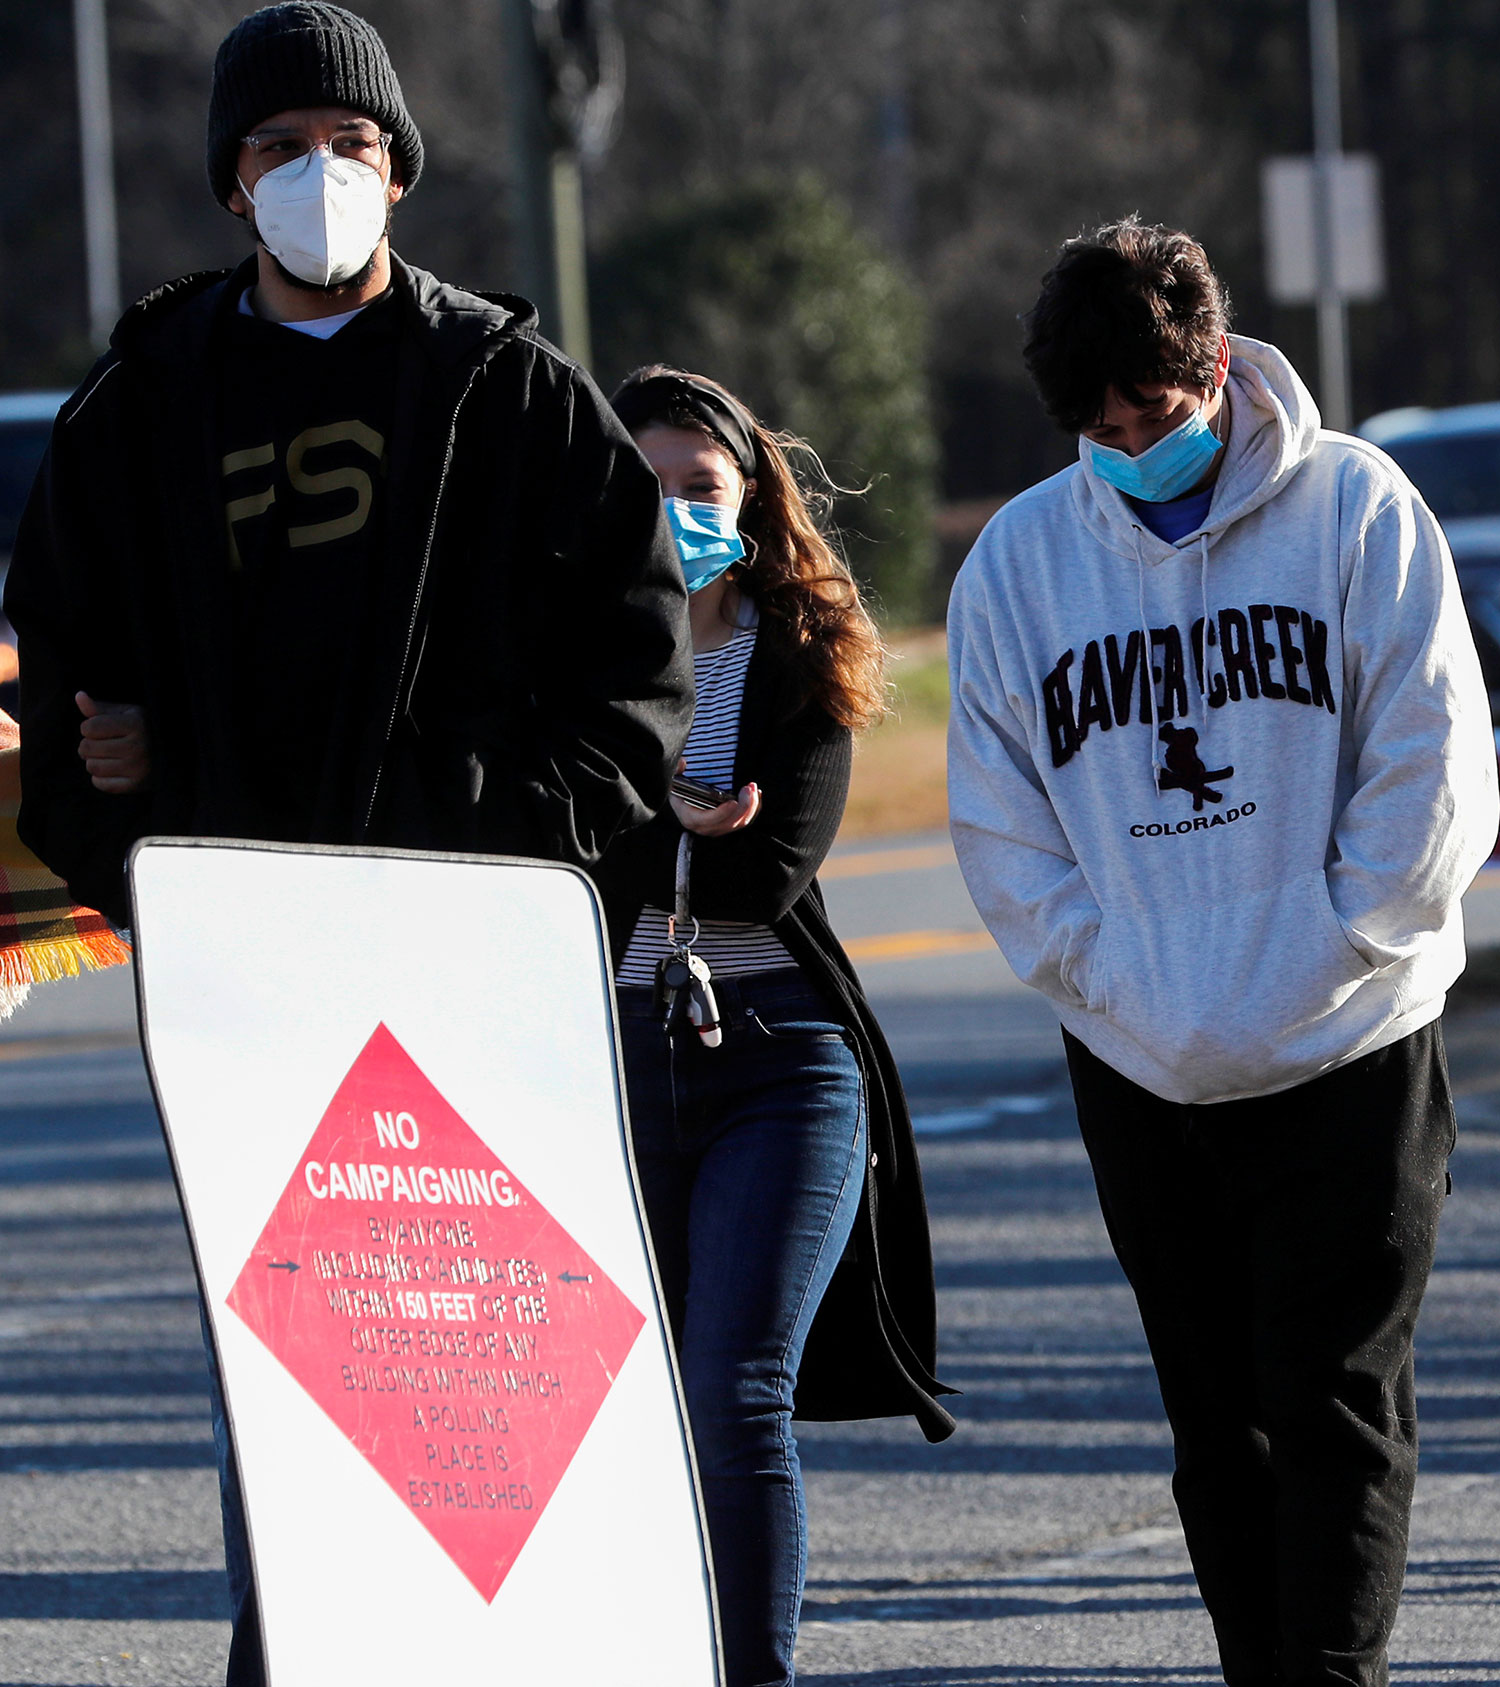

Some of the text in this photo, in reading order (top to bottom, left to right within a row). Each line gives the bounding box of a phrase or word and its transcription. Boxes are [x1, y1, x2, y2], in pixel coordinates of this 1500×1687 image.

[1190, 603, 1338, 714] CREEK
[1129, 801, 1257, 838] COLORADO
[373, 1110, 420, 1150] NO
[368, 1217, 394, 1244] BY
[325, 1288, 550, 1325] WITHIN 150 FEET OF THE
[350, 1326, 540, 1361] OUTER EDGE OF ANY
[341, 1365, 564, 1399] BUILDING WITHIN WHICH
[413, 1405, 510, 1433] A POLLING
[425, 1443, 509, 1472] PLACE IS
